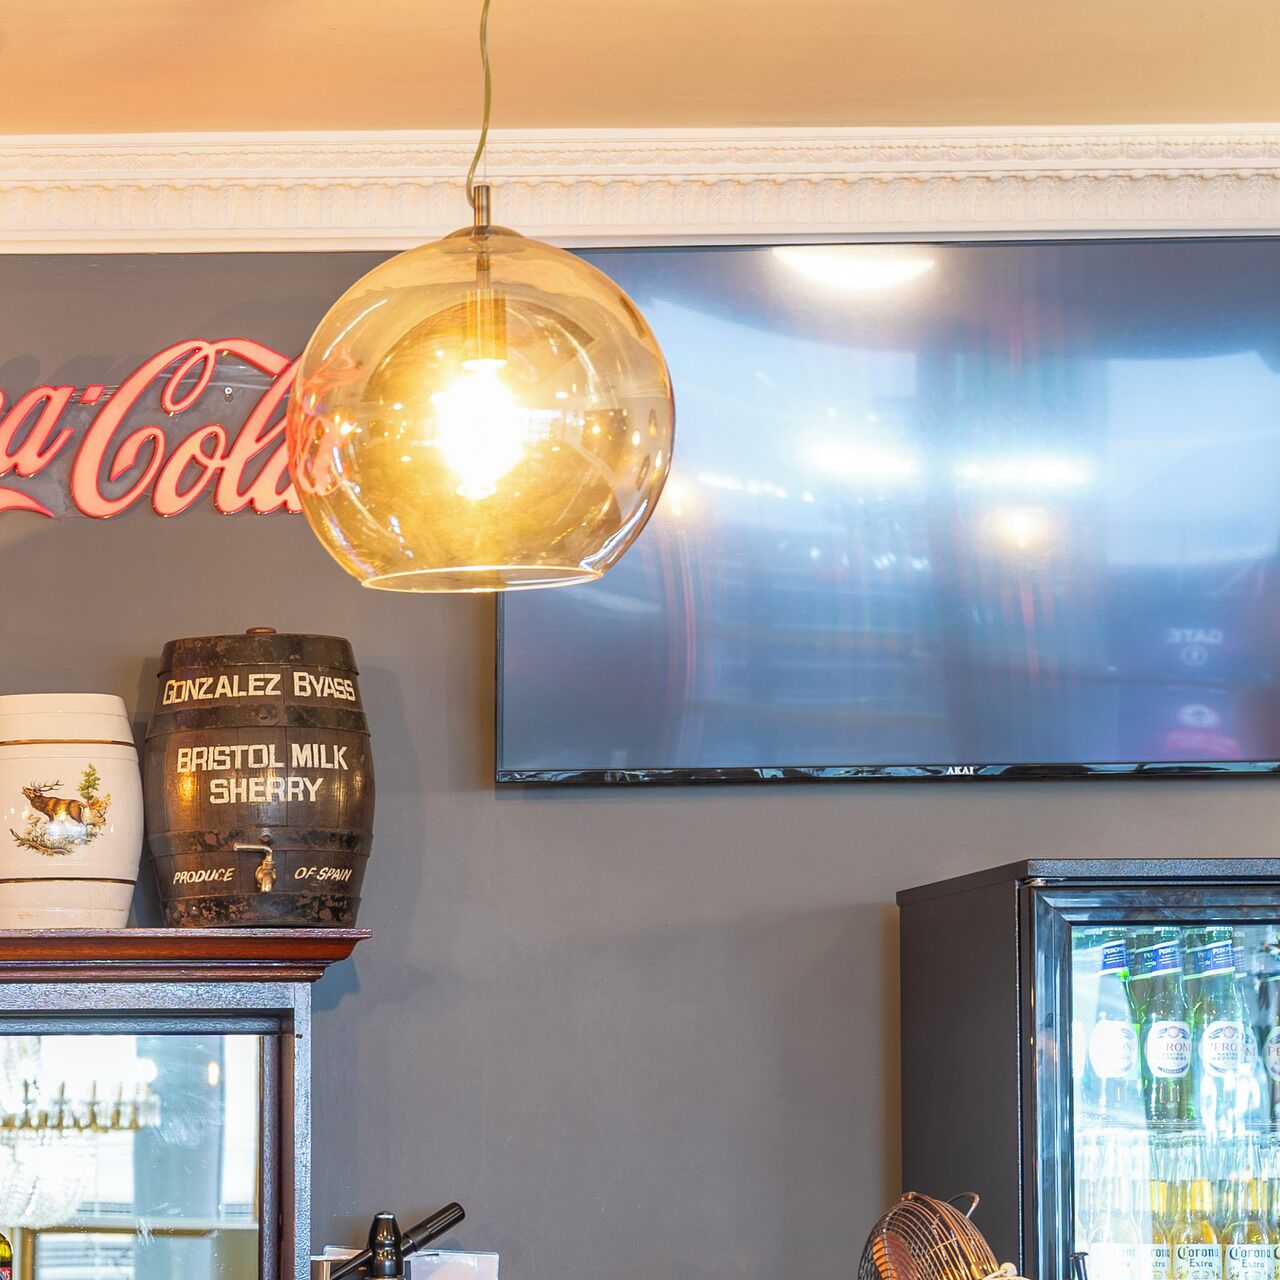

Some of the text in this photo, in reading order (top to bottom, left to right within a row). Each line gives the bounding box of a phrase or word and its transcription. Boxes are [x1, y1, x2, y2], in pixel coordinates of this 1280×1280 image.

[162, 671, 357, 705] GONZALEZ BYASS
[176, 743, 348, 773] BRISTOL MILK
[946, 766, 974, 775] AKAI
[208, 776, 326, 805] SHERRY
[172, 866, 352, 885] PRODUCE OF SPAIN
[1177, 1245, 1219, 1260] Corona
[1229, 1246, 1271, 1260] Corona
[1190, 1259, 1212, 1267] Extra
[1242, 1259, 1264, 1267] Extra
